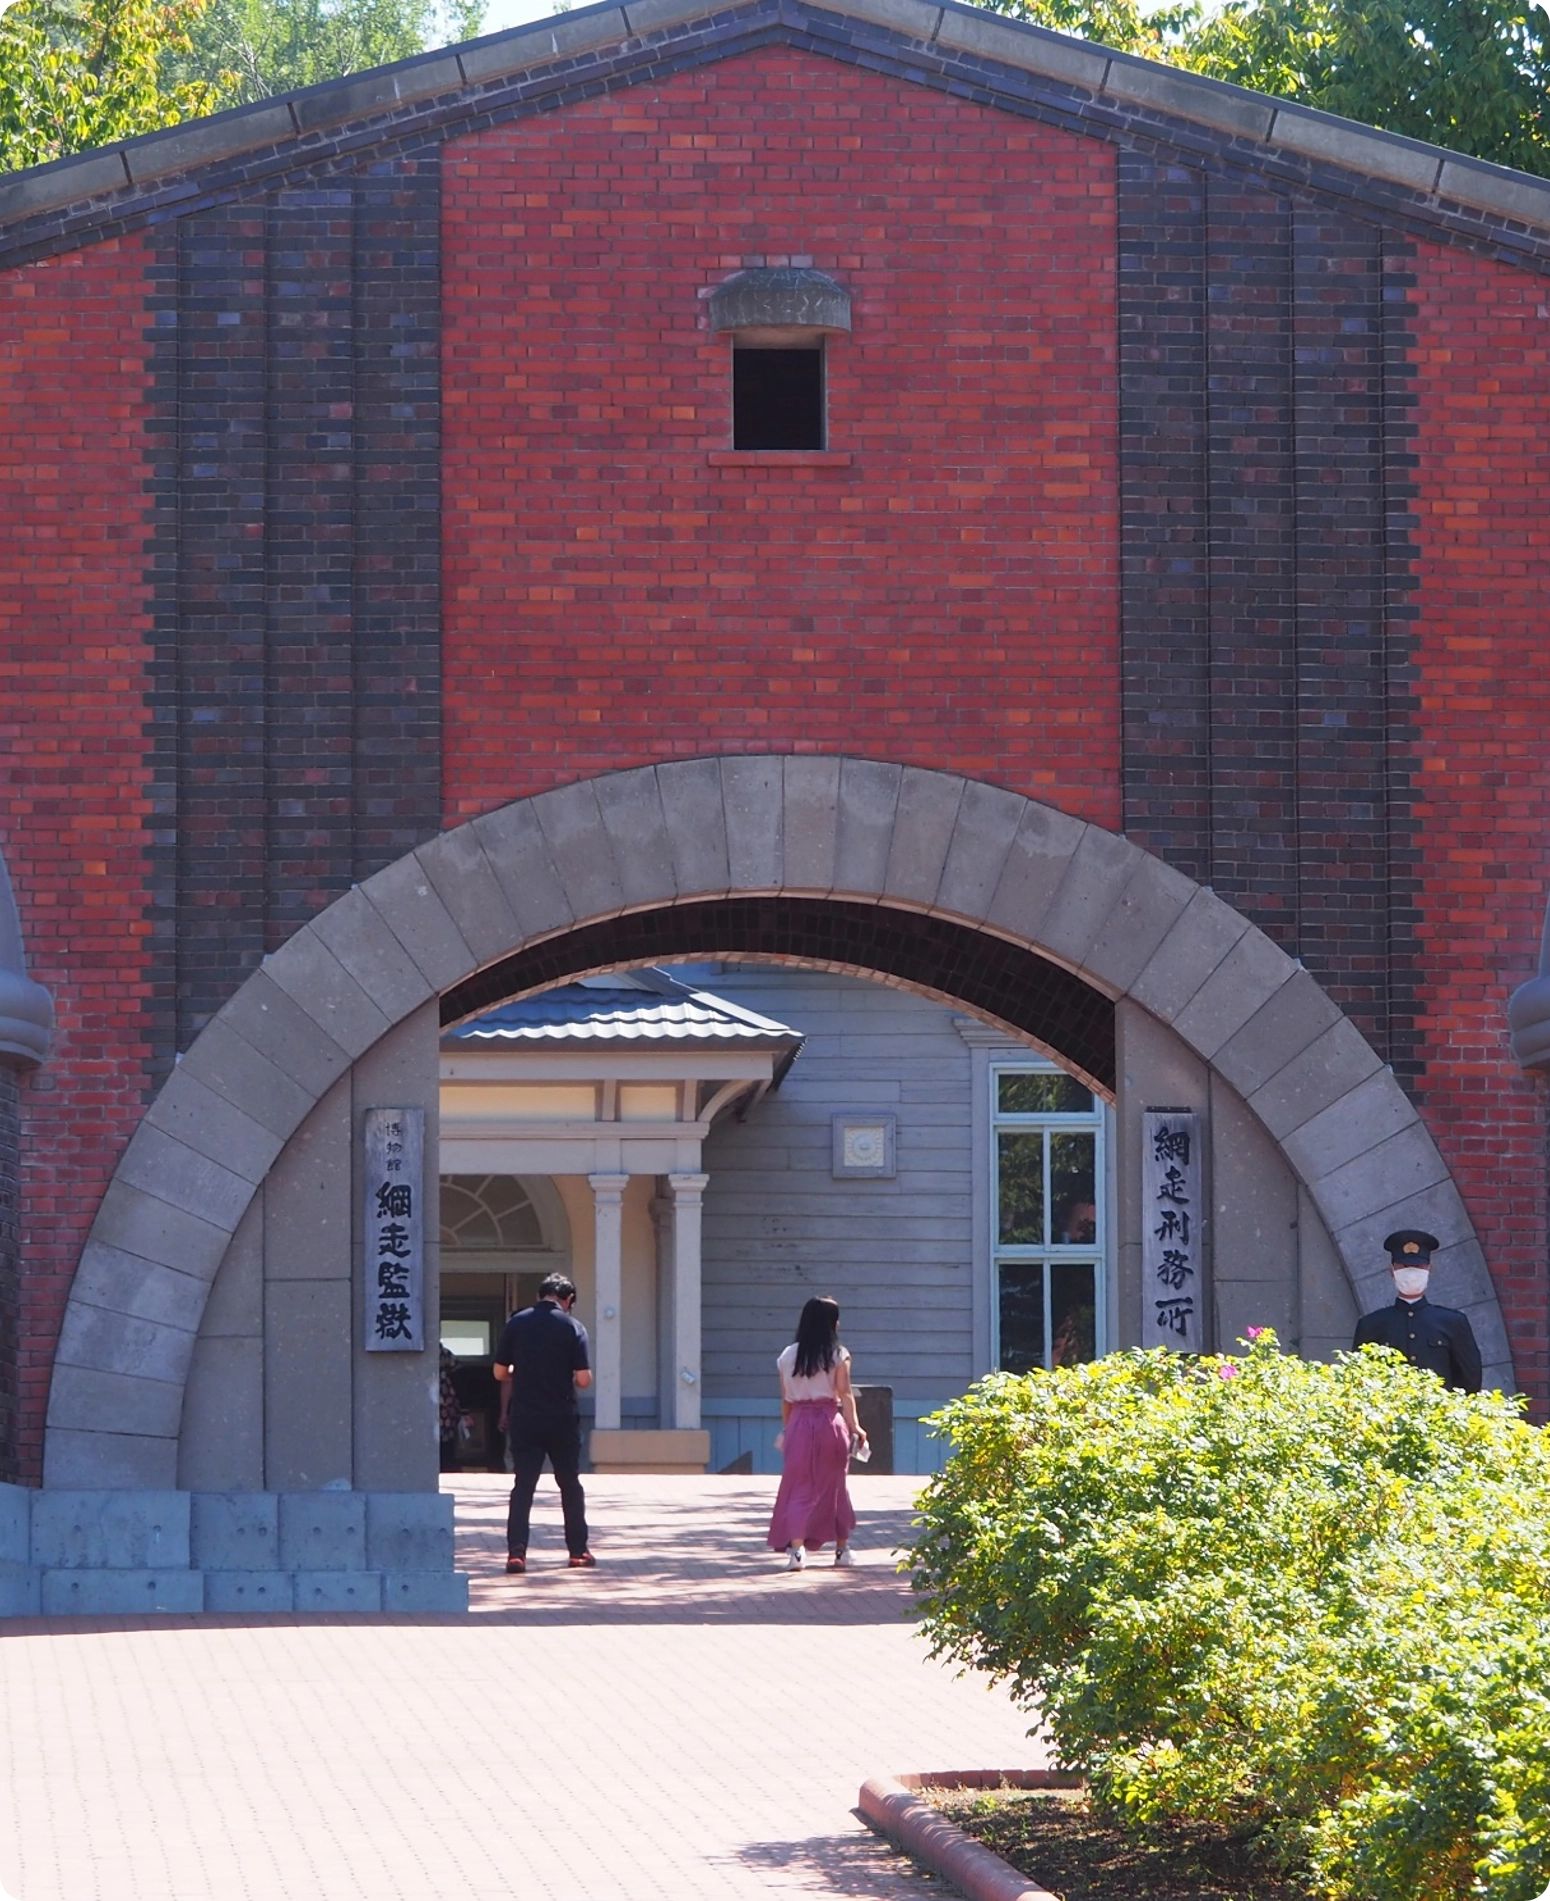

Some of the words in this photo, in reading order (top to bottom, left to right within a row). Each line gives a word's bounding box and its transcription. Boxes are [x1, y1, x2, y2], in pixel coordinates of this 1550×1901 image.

[385, 1121, 402, 1172] 博物館
[375, 1181, 413, 1340] 網走監獄
[1153, 1126, 1194, 1337] 網走刑務所
